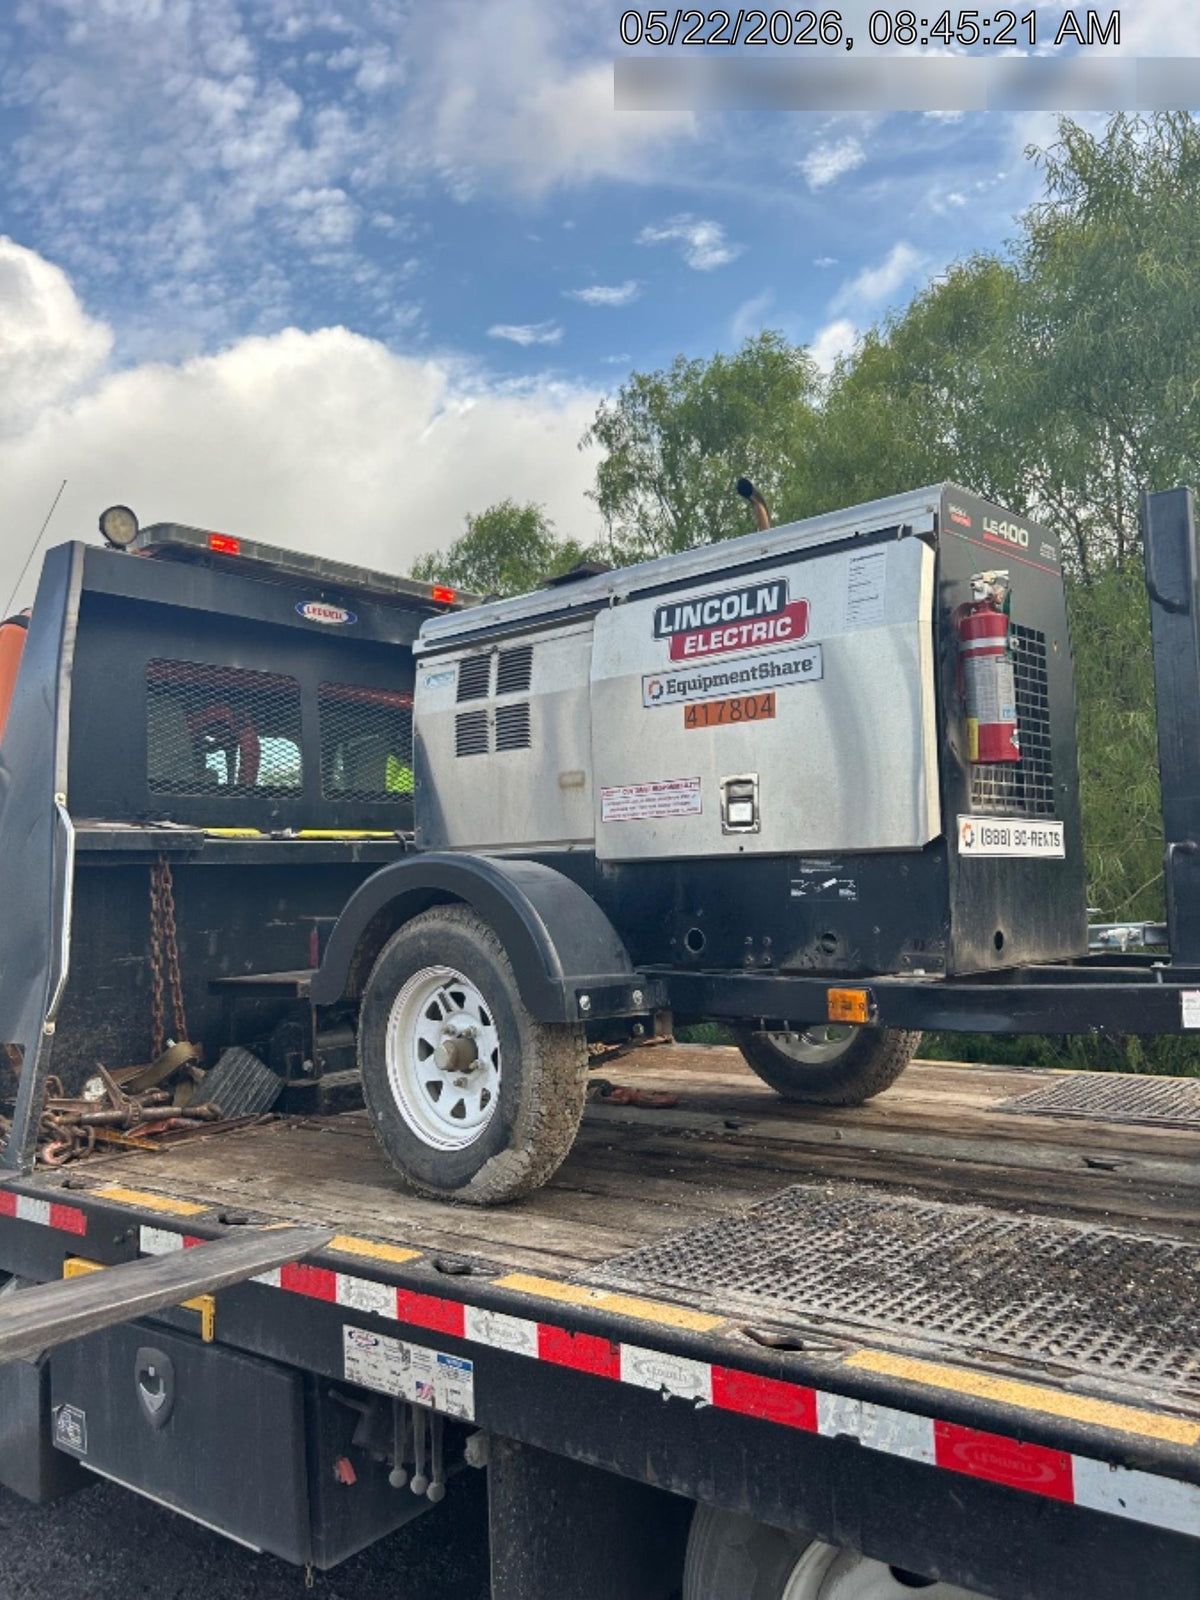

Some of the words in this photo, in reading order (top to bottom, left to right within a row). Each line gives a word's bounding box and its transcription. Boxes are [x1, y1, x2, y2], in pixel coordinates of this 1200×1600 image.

[659, 585, 780, 634] LINCOLN
[683, 617, 793, 655] ELECTRIC
[666, 656, 813, 696] EquipmentShare
[686, 695, 773, 727] 417804
[980, 827, 1011, 847] (888)
